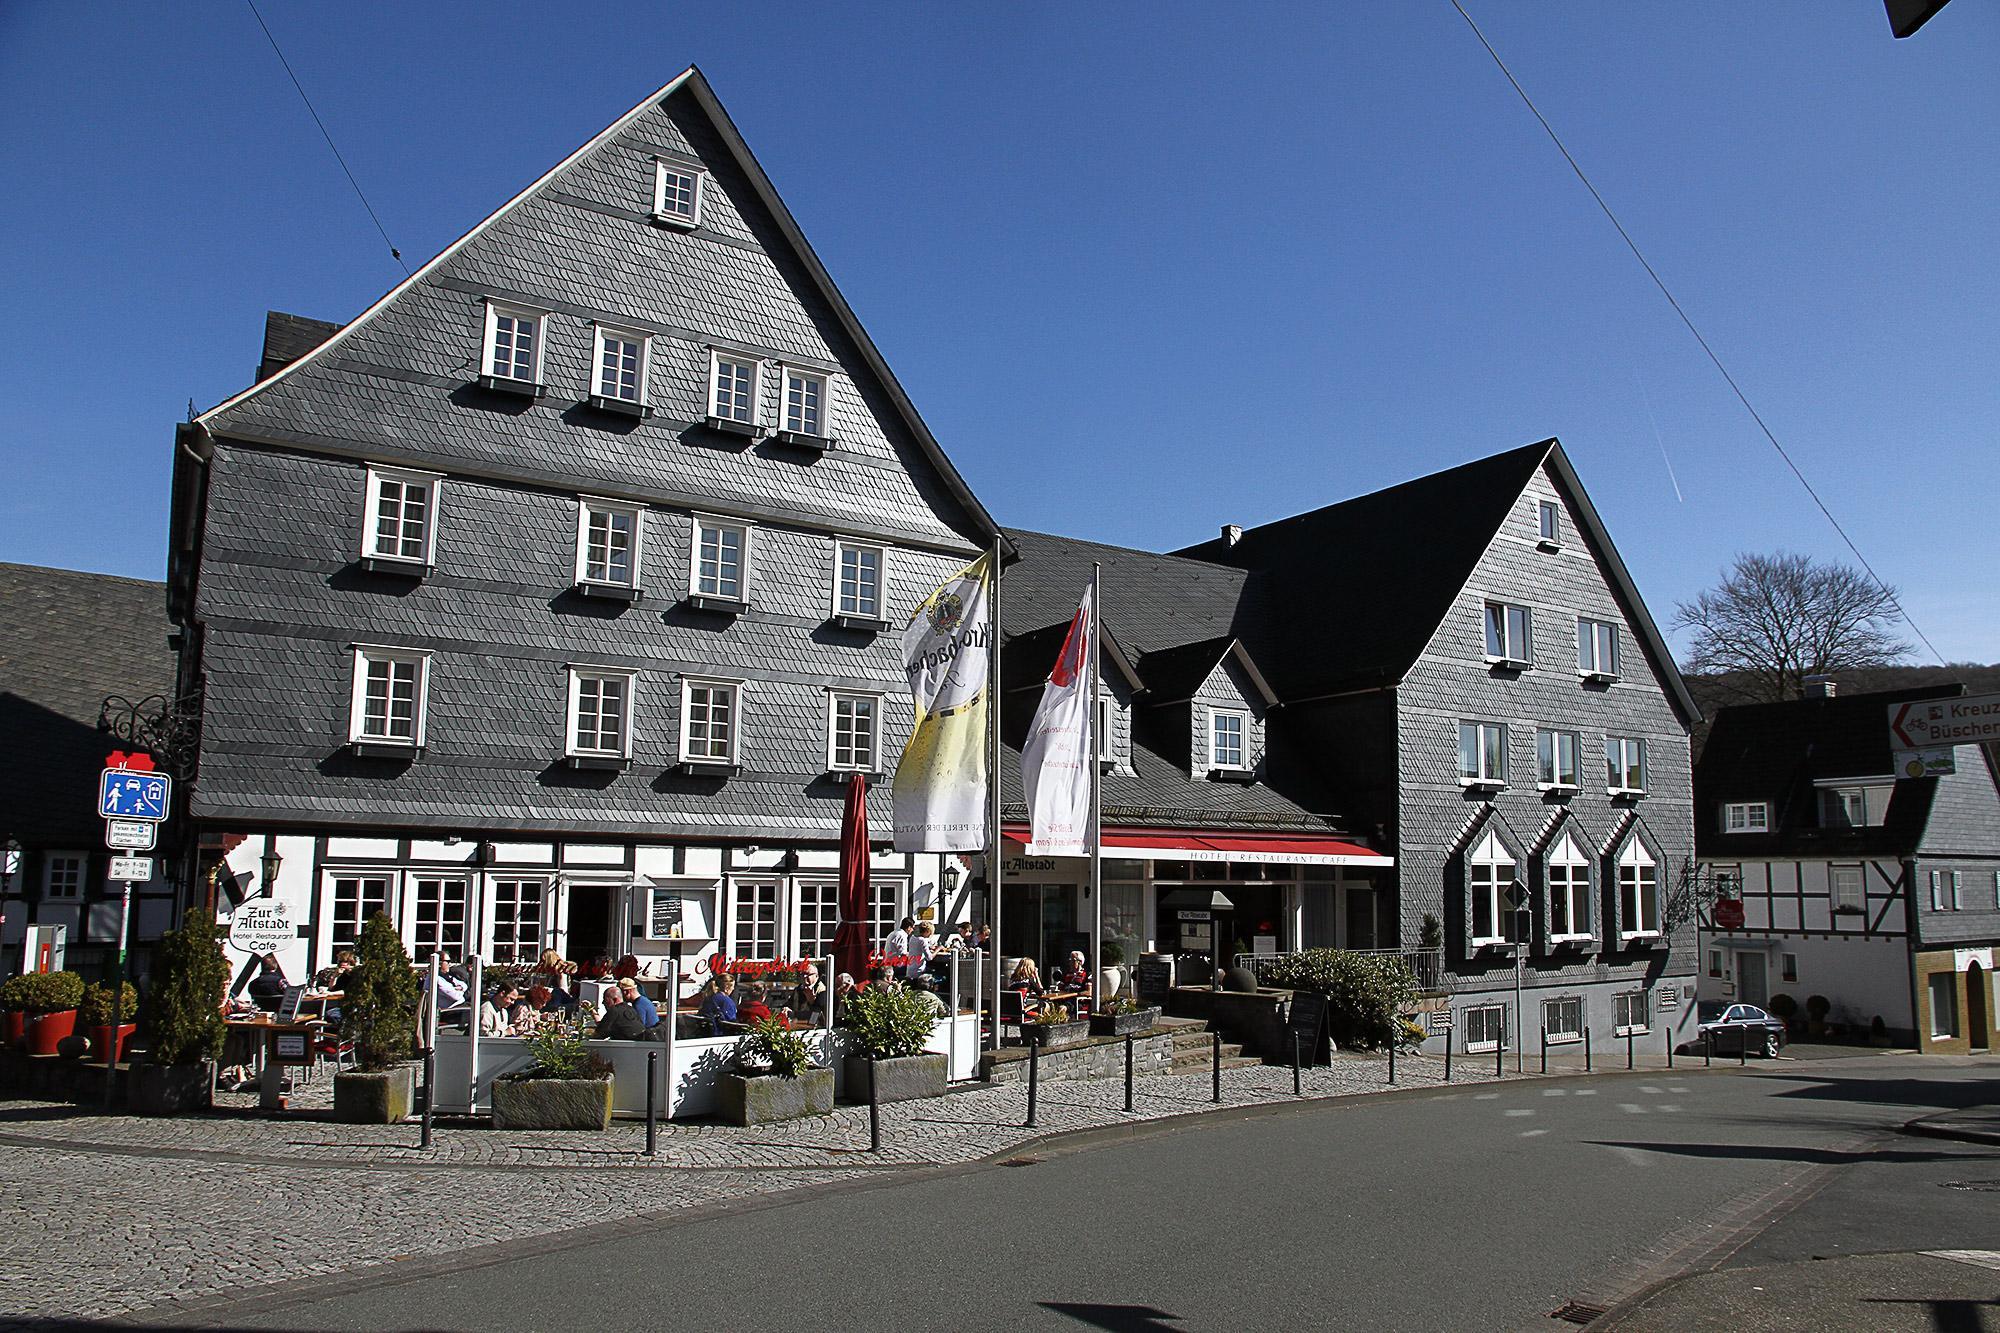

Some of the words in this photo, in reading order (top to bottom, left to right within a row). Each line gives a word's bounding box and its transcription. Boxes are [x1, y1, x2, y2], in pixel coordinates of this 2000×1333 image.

[1950, 703, 2000, 718] Kreuz
[1190, 852, 1229, 860] HOTEL
[1240, 853, 1313, 863] RESTAURANT
[1012, 858, 1056, 870] Altstadt
[247, 907, 272, 918] Zur
[237, 917, 290, 929] Altstadt
[255, 932, 294, 940] Restaurant
[249, 940, 277, 951] Cafe
[695, 952, 811, 978] Mittagstisch
